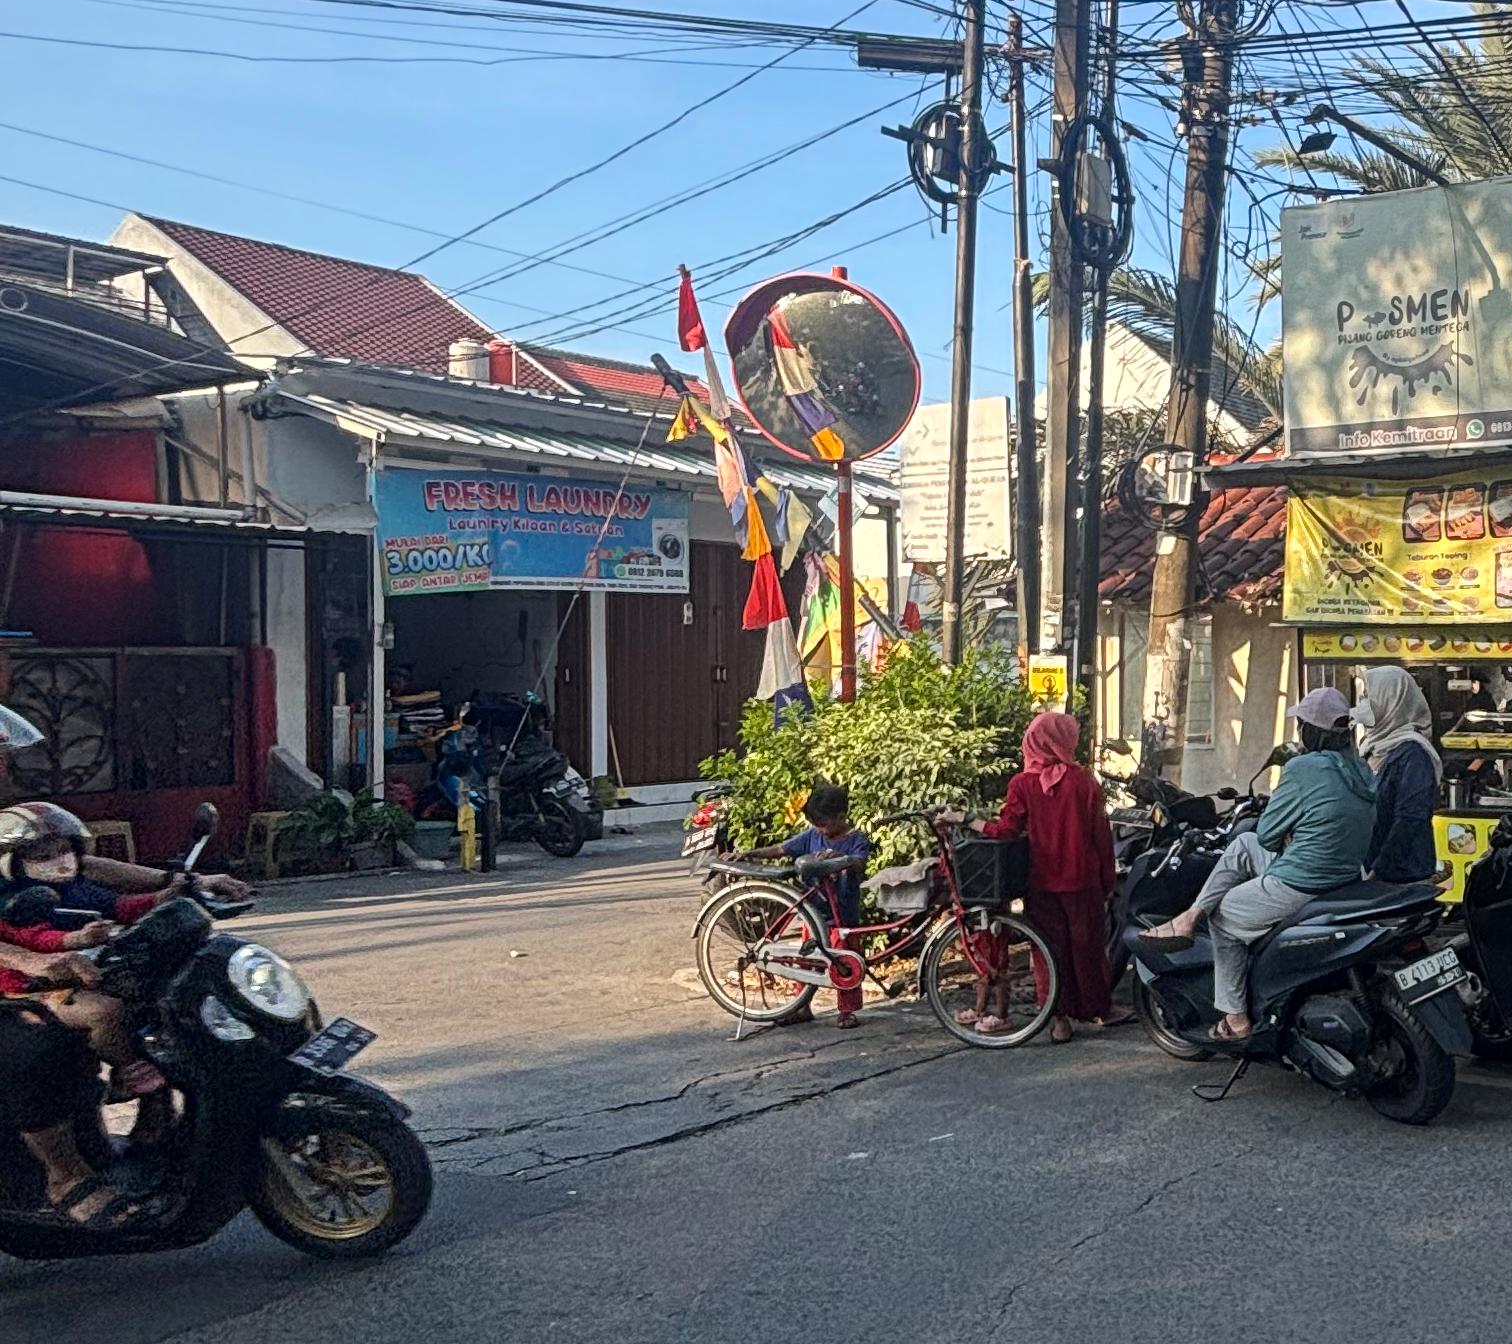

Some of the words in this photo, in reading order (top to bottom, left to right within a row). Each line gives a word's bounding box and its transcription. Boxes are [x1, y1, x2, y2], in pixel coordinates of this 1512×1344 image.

[1338, 331, 1373, 345] PISANG
[1376, 327, 1417, 341] GORENG
[1420, 320, 1471, 337] MENTEGA
[1338, 433, 1370, 450] Info
[1371, 425, 1458, 448] Kemitraan
[424, 481, 520, 511] FRESH
[526, 484, 651, 519] LAUNDRY
[512, 518, 557, 533] Kiloan
[561, 521, 570, 534] &
[1399, 973, 1408, 987] B
